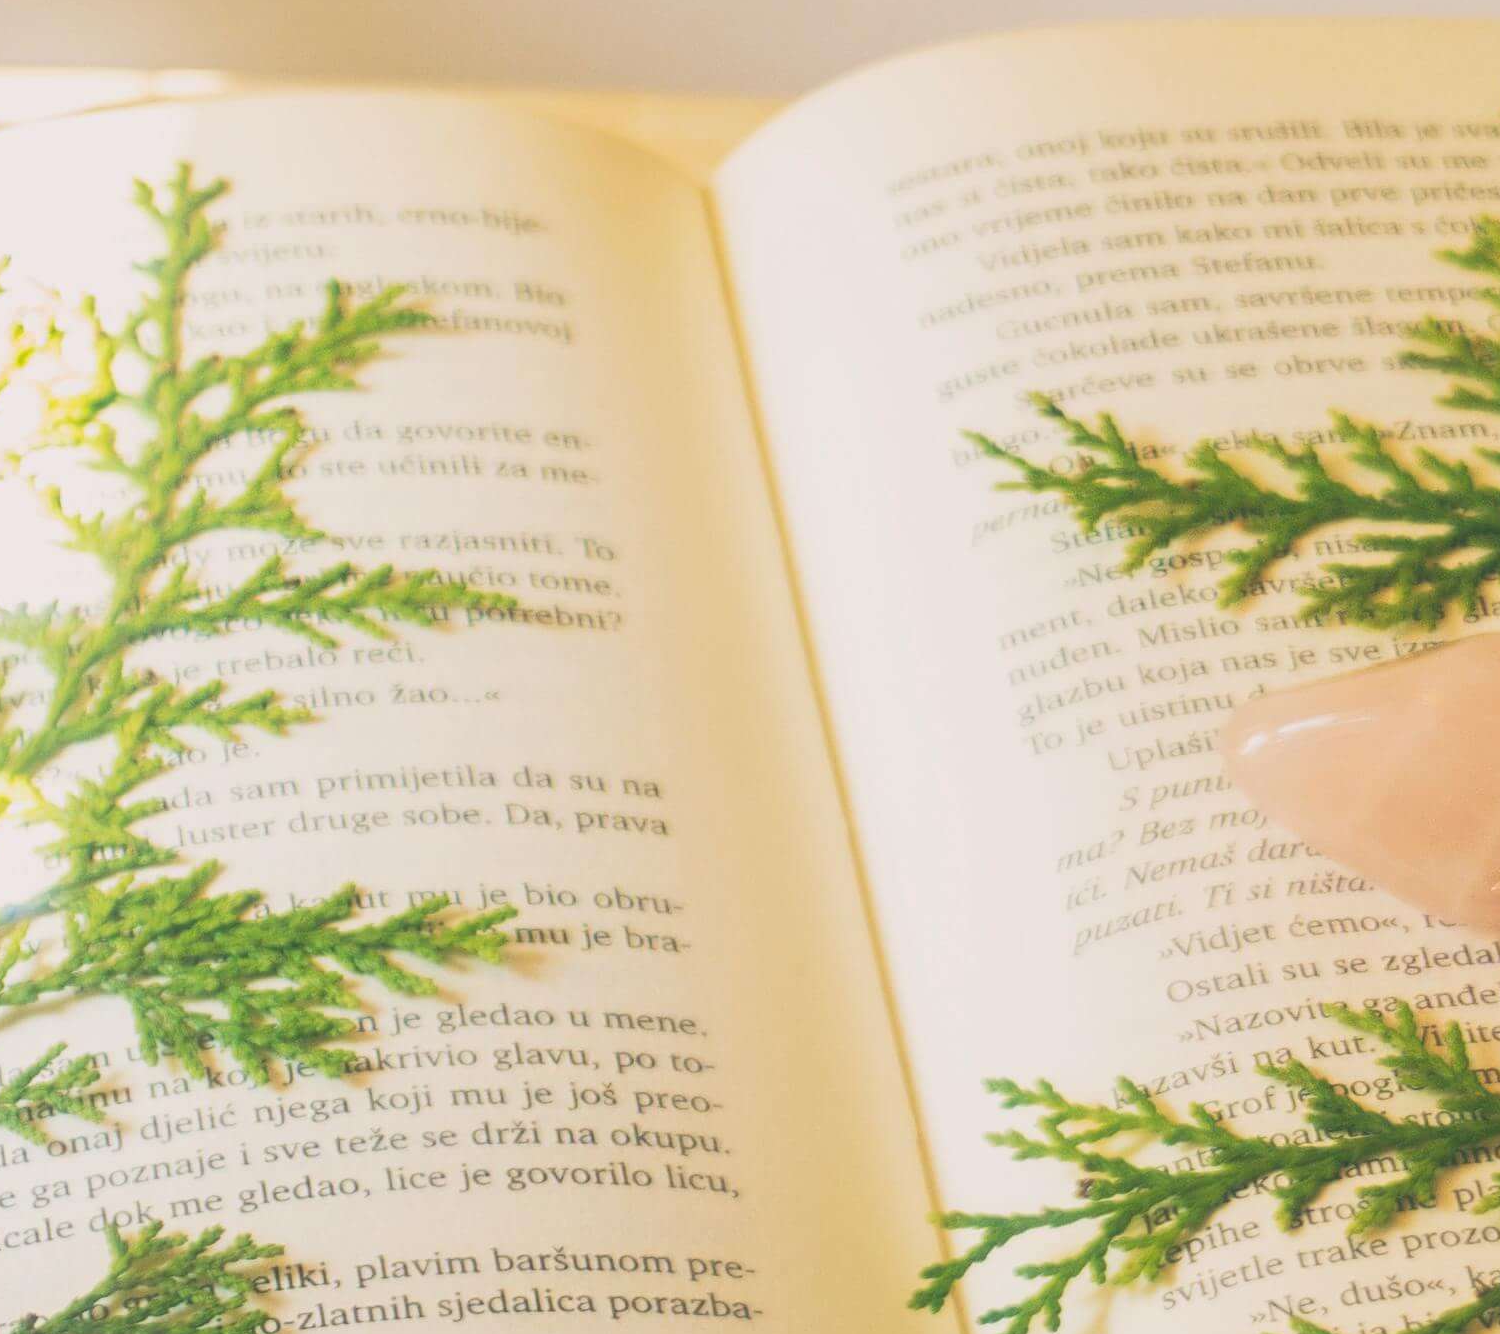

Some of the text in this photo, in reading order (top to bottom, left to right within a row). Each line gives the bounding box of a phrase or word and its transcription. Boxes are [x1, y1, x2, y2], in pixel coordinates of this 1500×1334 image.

[174, 636, 425, 688] je trebalo reći.
[177, 803, 671, 849] luster druge sobe. Da, prava
[1166, 964, 1270, 1003] Ostali
[1282, 962, 1321, 981] su
[1334, 958, 1369, 975] se
[31, 1180, 71, 1209] ga
[86, 1153, 226, 1200] poznaje
[241, 1149, 251, 1166] i
[264, 1141, 321, 1163] sve
[335, 1128, 408, 1155] teže
[422, 1131, 457, 1148] se
[471, 1121, 541, 1146] drži
[555, 1127, 598, 1146] na
[610, 1123, 731, 1157] okupu.
[88, 1201, 153, 1233] dok
[170, 1195, 223, 1218] me
[238, 1175, 372, 1214] gledao,
[385, 1167, 447, 1192] lice
[462, 1163, 491, 1193] je
[506, 1162, 654, 1192] govorilo
[666, 1164, 742, 1200] licu,
[356, 1246, 756, 1289] plavim baršunom pre-
[438, 1287, 764, 1323] sjedalica porazba-
